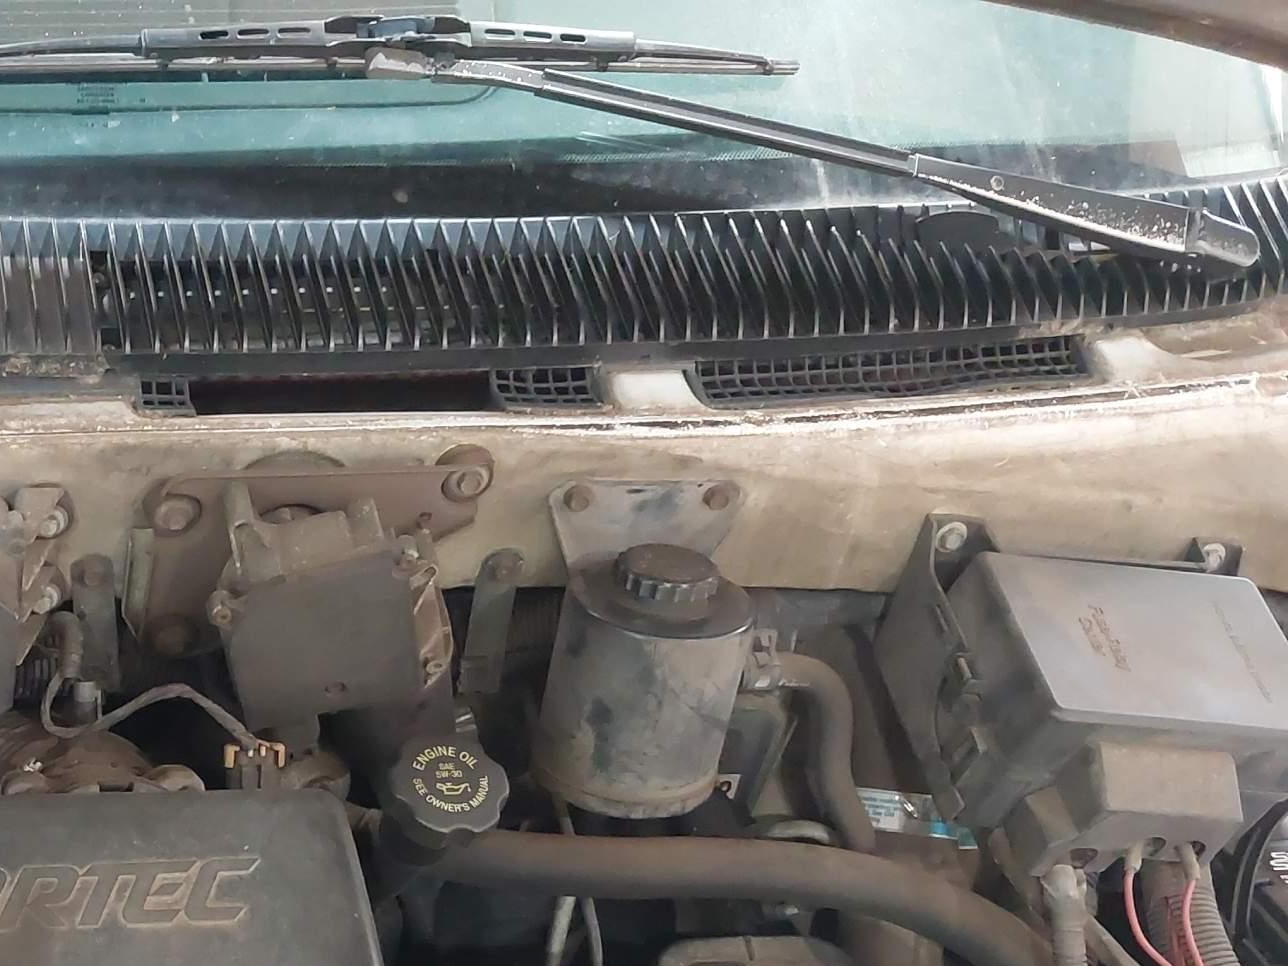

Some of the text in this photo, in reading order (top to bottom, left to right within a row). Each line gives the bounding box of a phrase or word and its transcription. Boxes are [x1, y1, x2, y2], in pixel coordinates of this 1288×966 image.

[413, 746, 479, 770] ENGINE OIL
[436, 770, 463, 778] 5W-30
[413, 775, 489, 813] SEE OWNER'S MANUAL
